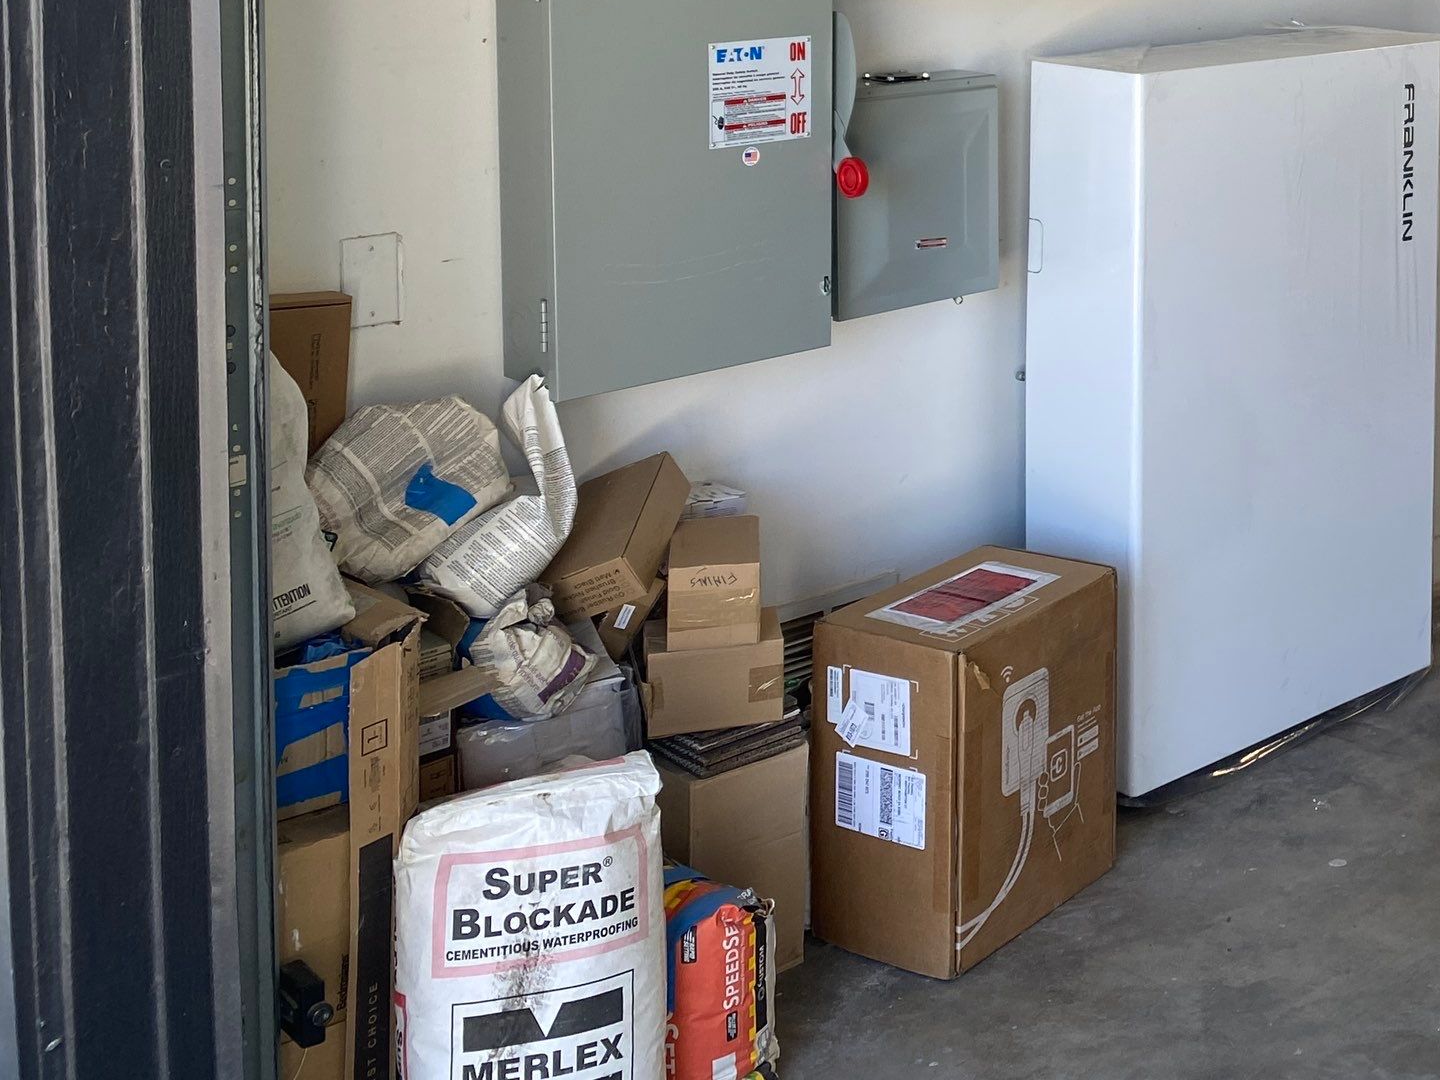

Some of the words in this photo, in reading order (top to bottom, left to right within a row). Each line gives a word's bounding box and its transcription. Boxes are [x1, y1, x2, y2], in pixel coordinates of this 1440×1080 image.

[716, 46, 762, 63] EATON
[789, 41, 806, 62] ON
[790, 111, 807, 135] OFF
[1401, 83, 1415, 242] FRANKLIN
[452, 886, 635, 941] BLOCKADE
[446, 940, 539, 962] CEMENTITIOUS
[542, 916, 639, 955] WATERPROOFING
[367, 982, 378, 1049] CHOICE
[367, 1057, 376, 1080] ST
[462, 1032, 623, 1080] MERLEX
